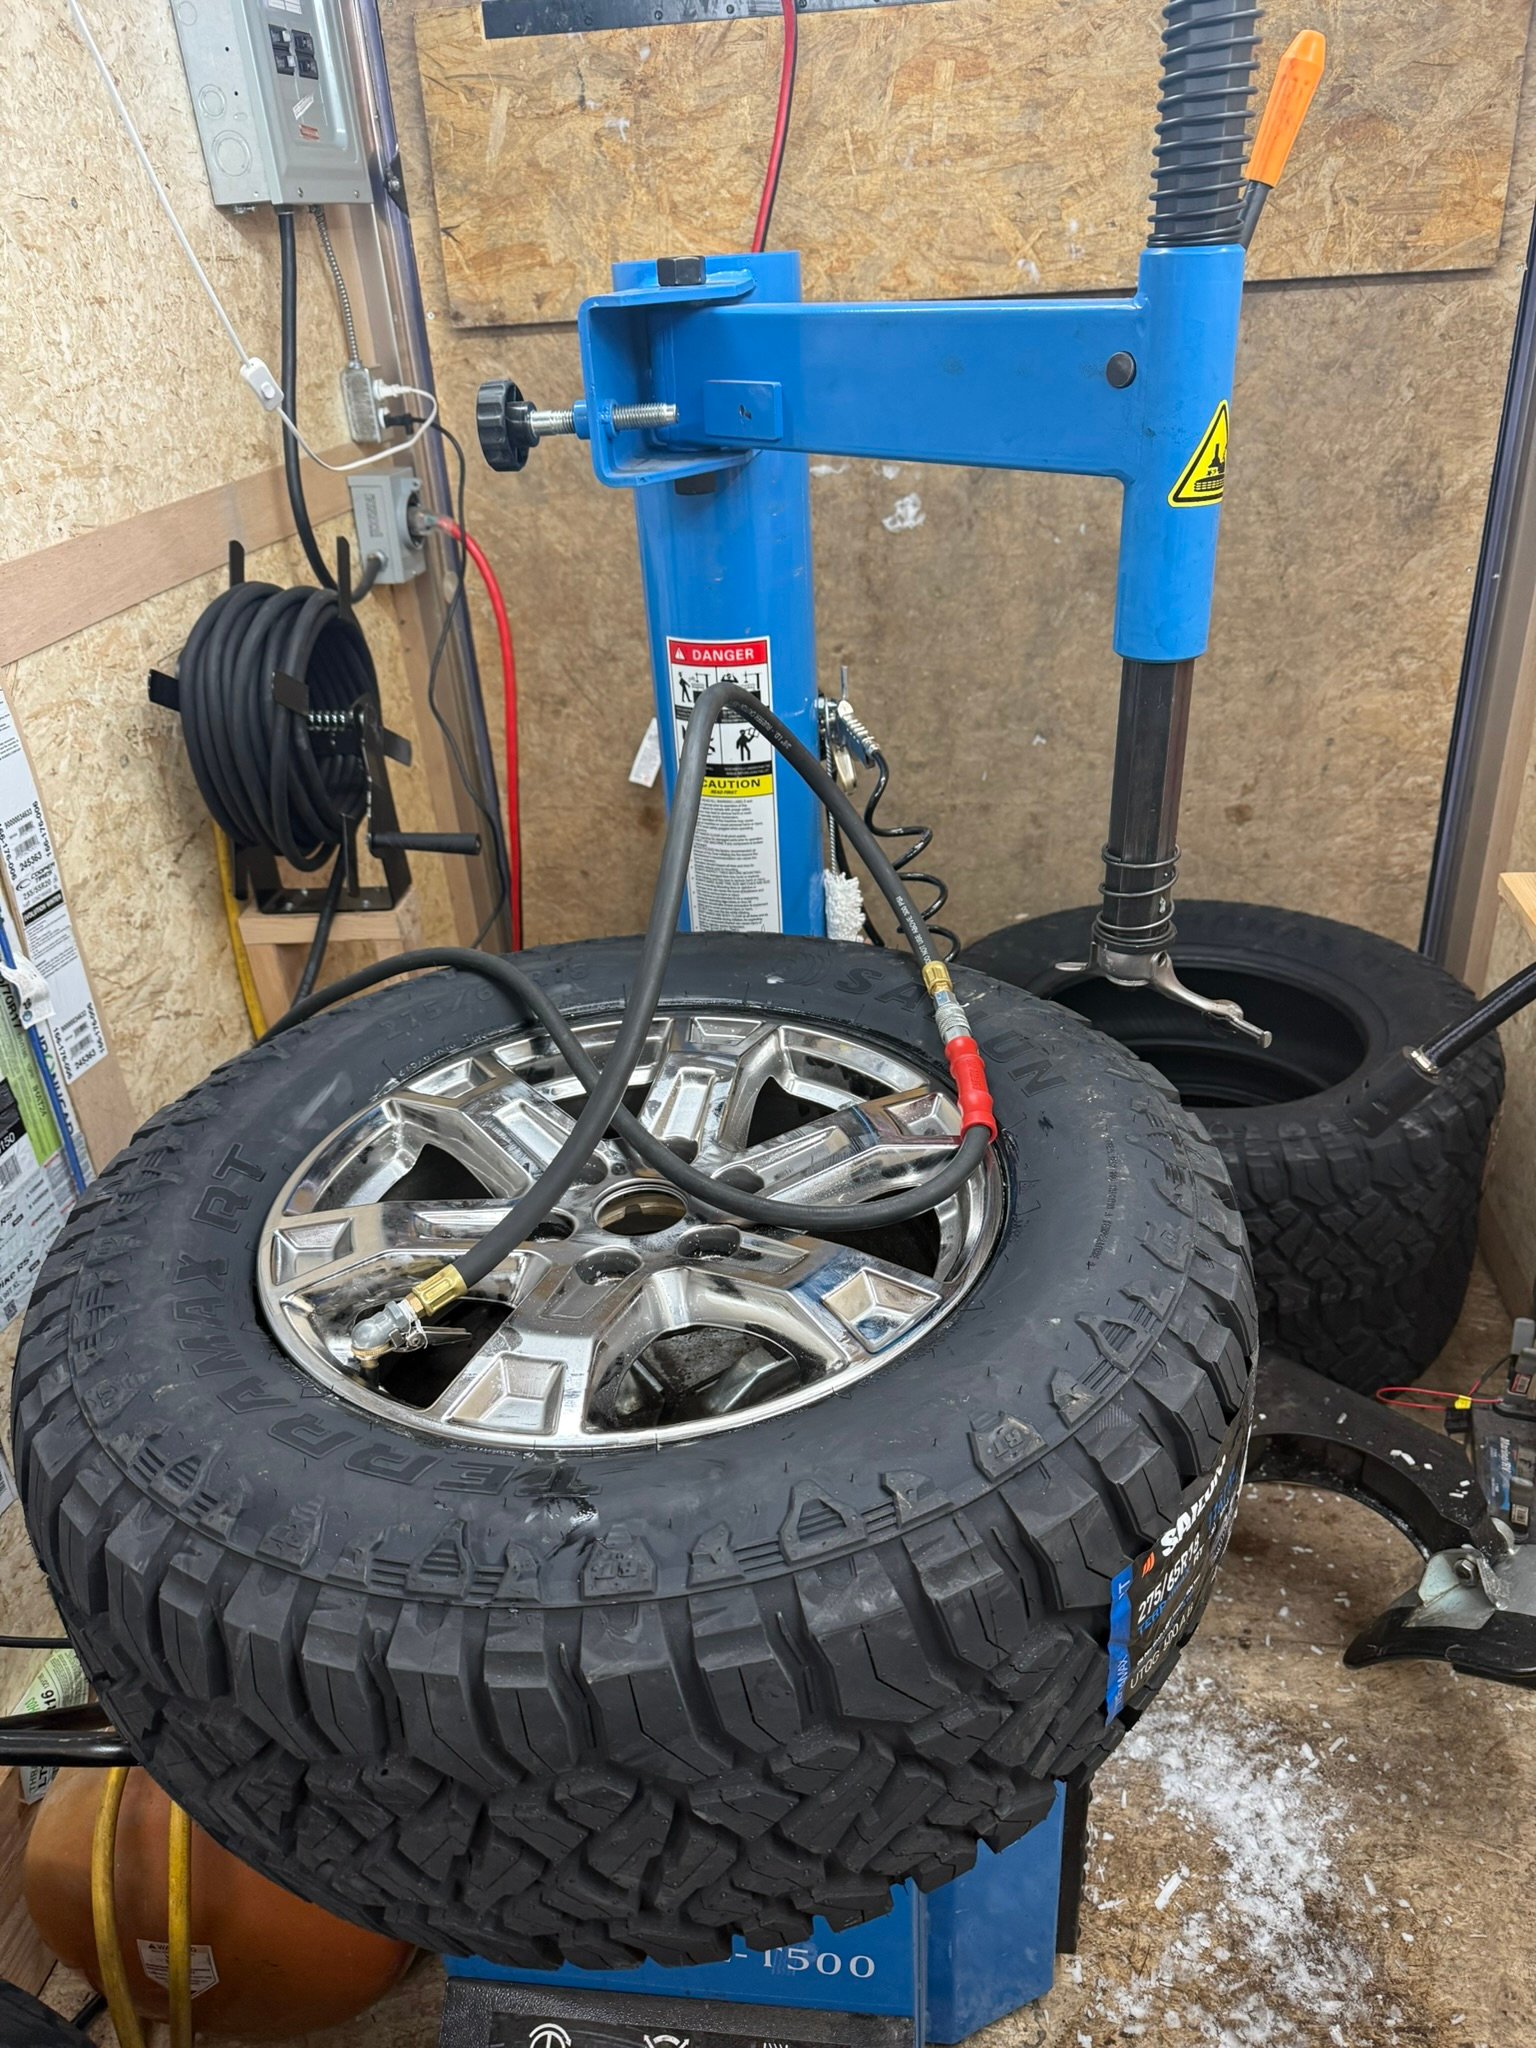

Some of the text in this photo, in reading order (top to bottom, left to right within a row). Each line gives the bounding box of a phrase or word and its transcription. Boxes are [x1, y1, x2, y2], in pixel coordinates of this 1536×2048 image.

[692, 647, 755, 662] DANGER
[0, 822, 17, 881] 66-176-006
[834, 967, 1068, 1098] SAUN
[0, 1131, 16, 1154] 150
[173, 1142, 603, 1498] TERRAMAX RT
[1160, 1454, 1227, 1557] SAILUN
[1138, 1532, 1200, 1625] 275/65R18
[38, 1766, 47, 1789] LT
